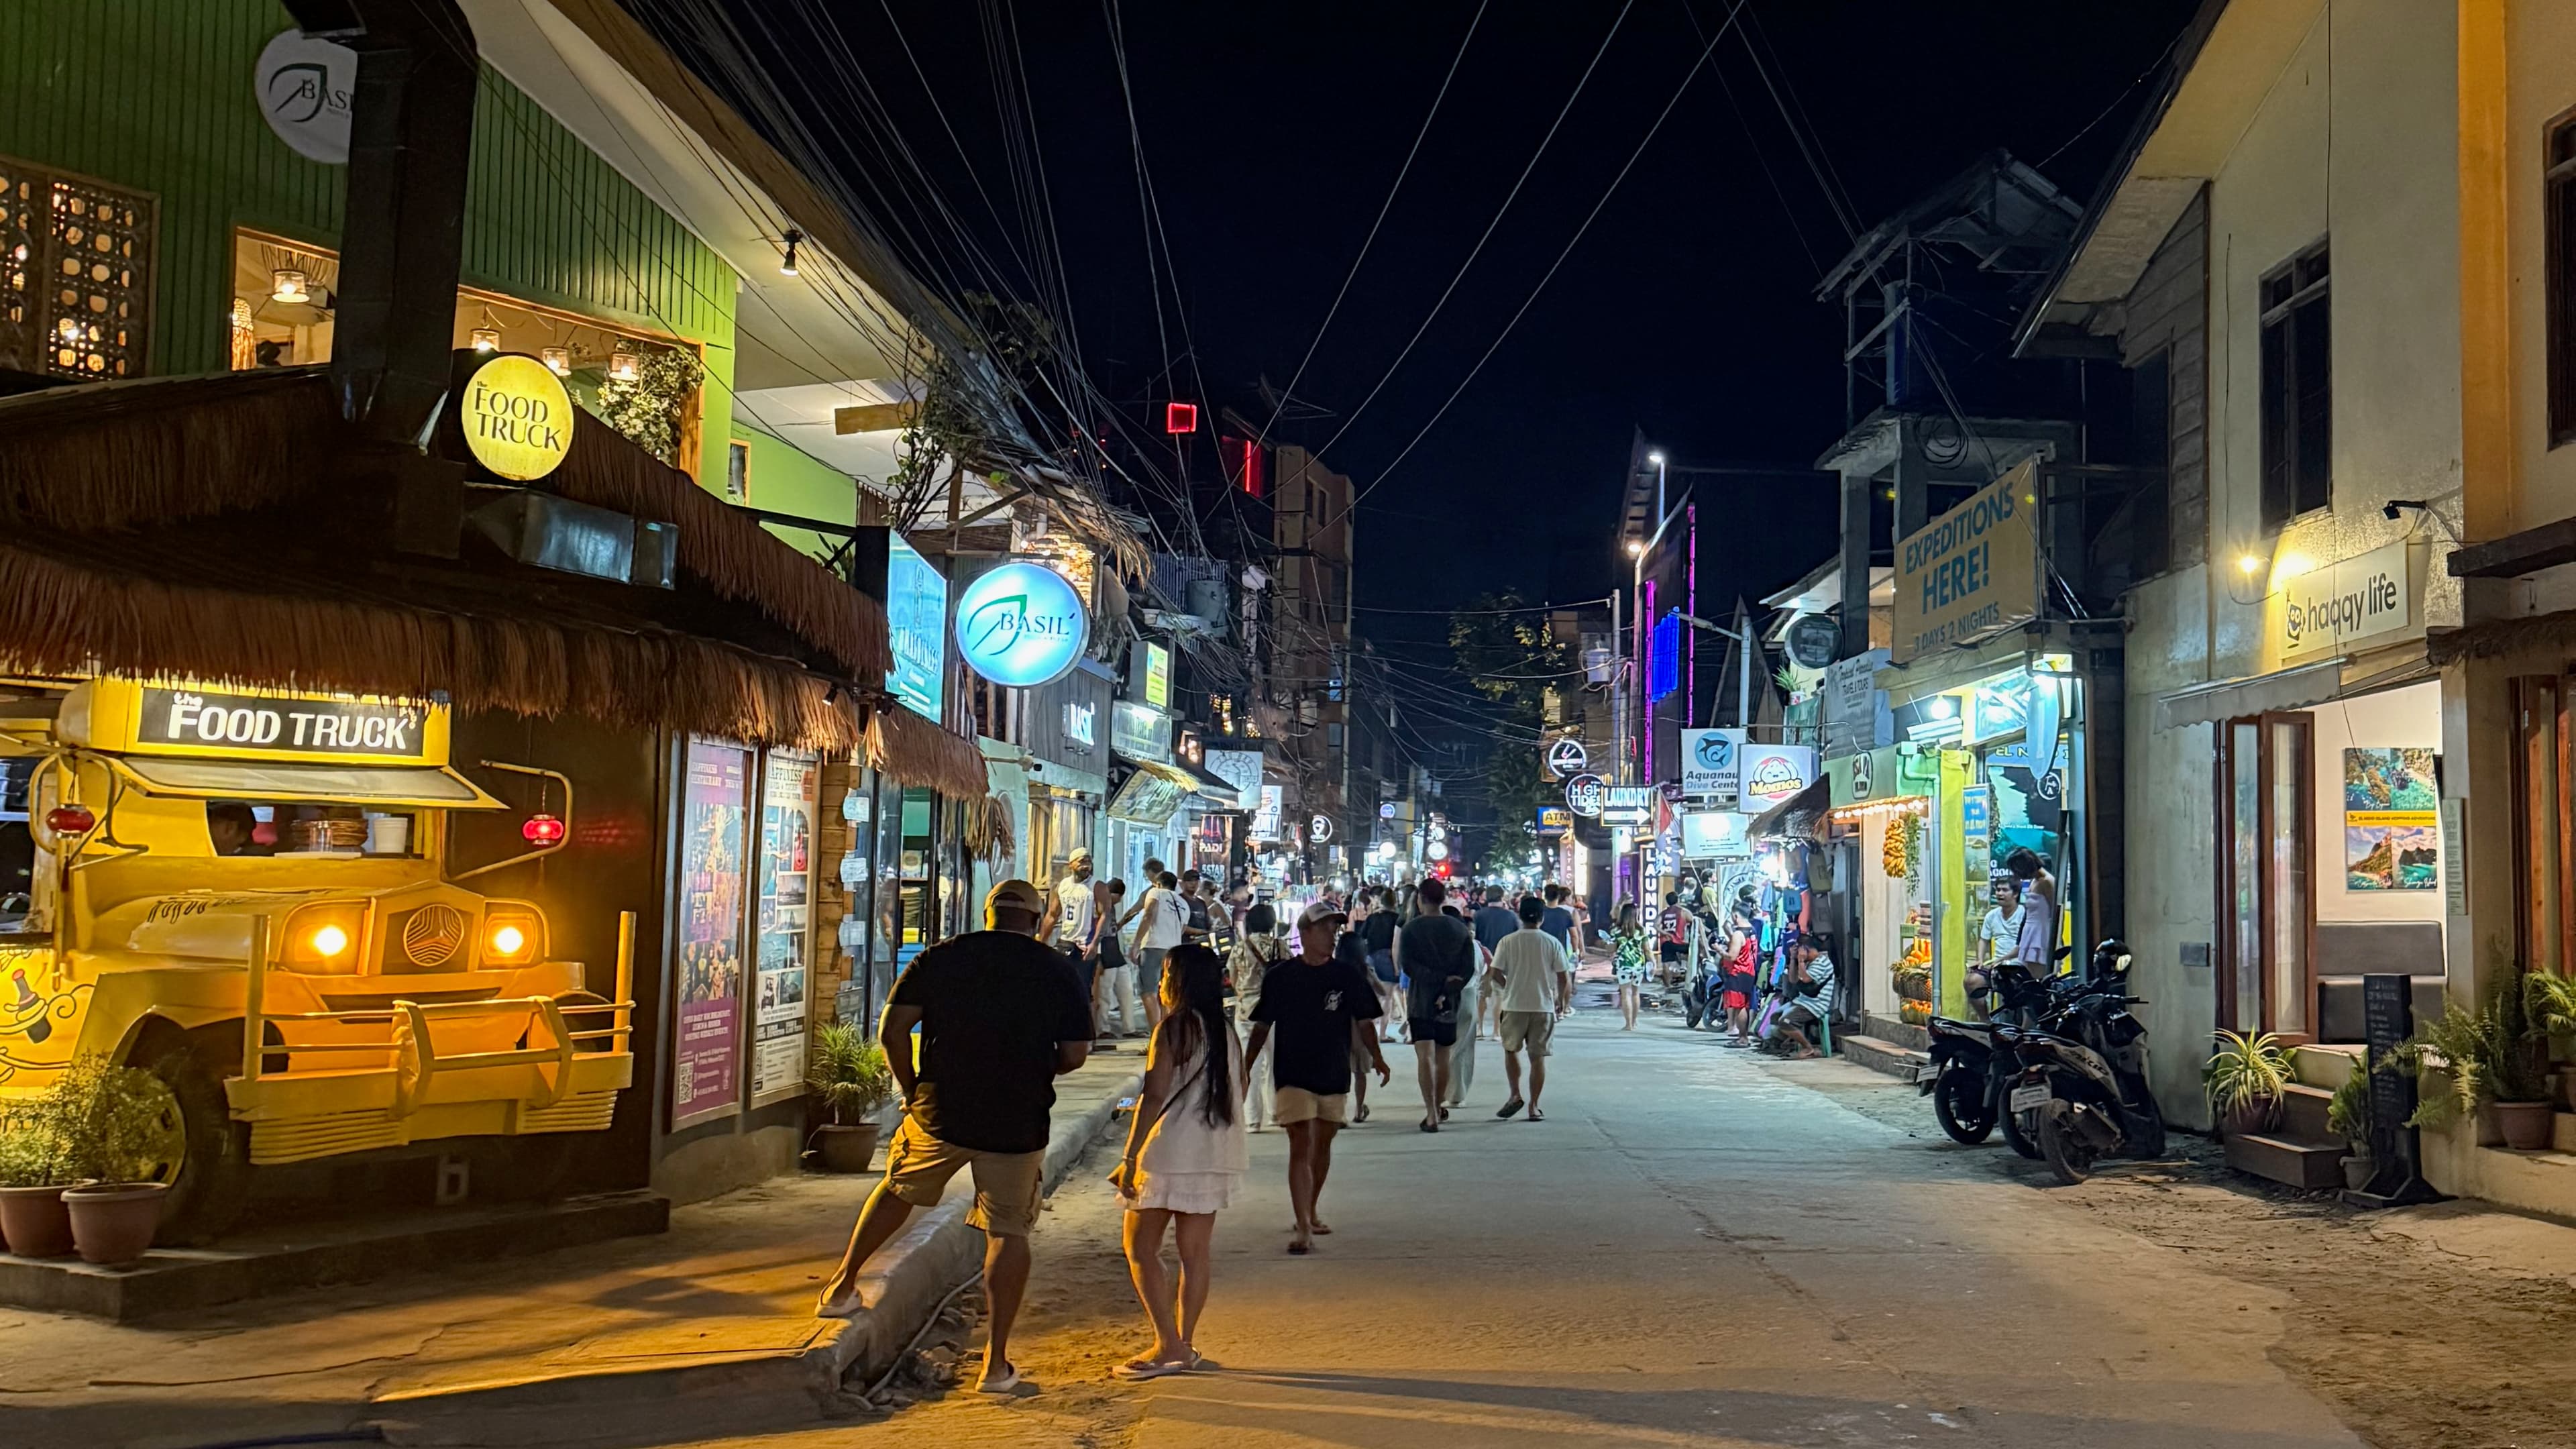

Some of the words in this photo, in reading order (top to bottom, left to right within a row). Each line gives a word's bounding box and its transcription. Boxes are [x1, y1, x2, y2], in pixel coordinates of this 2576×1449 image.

[302, 78, 354, 111] BASI
[475, 388, 548, 423] FOOD
[476, 412, 561, 451] TRUCK
[1905, 482, 2015, 575] EXPEDITIONS
[1922, 540, 1989, 614] HERE!
[2368, 572, 2397, 616] life
[1923, 625, 1945, 651] DAYS
[1948, 621, 1954, 638] 2
[1957, 601, 1999, 635] NIGHTS
[173, 692, 203, 706] the
[167, 704, 281, 744] FOOD
[288, 712, 409, 749] TRUCK
[1686, 771, 1737, 783] Aquanau
[1605, 788, 1650, 807] LAUNDRY
[1545, 812, 1571, 821] ATM
[1199, 843, 1223, 853] PADI
[1067, 905, 1075, 920] 6
[1664, 920, 1677, 932] 32
